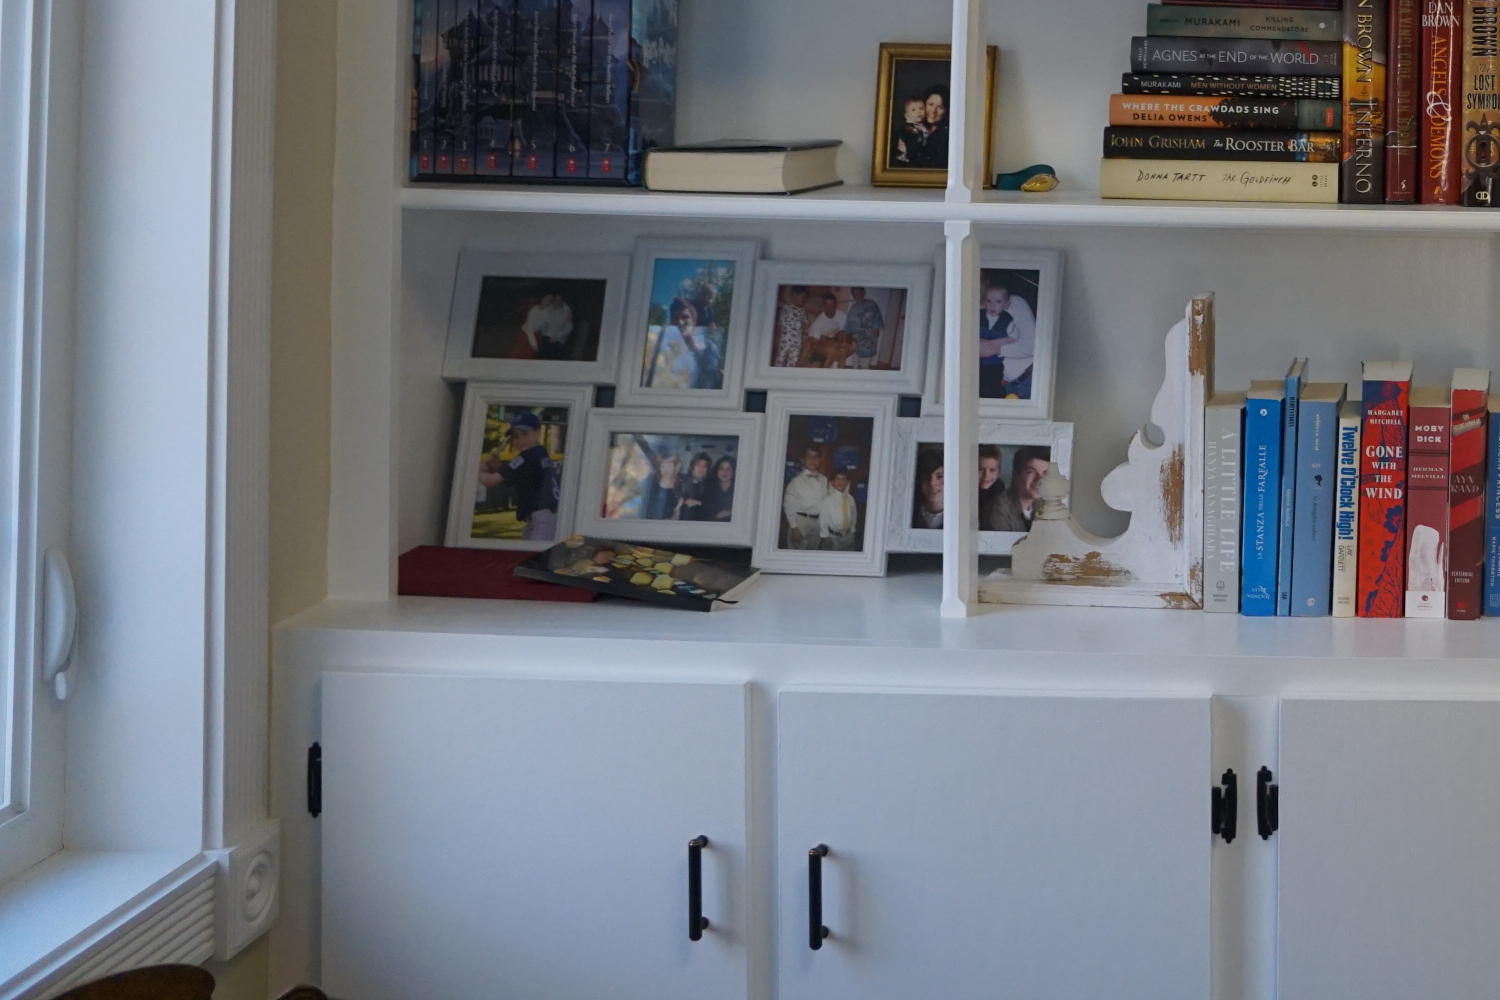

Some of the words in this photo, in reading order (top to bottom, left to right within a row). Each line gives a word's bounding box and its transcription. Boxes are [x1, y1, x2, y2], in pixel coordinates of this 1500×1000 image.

[1400, 0, 1413, 15] DA
[1428, 1, 1454, 14] DAN
[1184, 18, 1240, 27] MURAKAMI
[1421, 14, 1459, 27] BROWN
[1400, 17, 1413, 49] VINCI
[1471, 6, 1497, 57] BROWN
[1356, 14, 1372, 82] BROWN
[1152, 50, 1197, 62] AGNES
[1218, 50, 1247, 63] END
[1270, 51, 1319, 65] WORLD
[1430, 37, 1447, 94] ANGELS
[1400, 53, 1412, 80] CODE
[1209, 82, 1245, 90] WITHOUT
[1247, 83, 1277, 91] WOMEN
[1473, 75, 1496, 91] LOST
[1122, 103, 1160, 112] WHERE
[1164, 104, 1184, 112] THE
[1189, 104, 1250, 115] CRAWDADS
[1252, 105, 1279, 115] SING
[1399, 90, 1412, 112] DAN
[1425, 91, 1452, 121] &
[1466, 93, 1500, 110] SYMBOL
[1169, 114, 1207, 122] OWENS
[1110, 134, 1145, 148] JOHN
[1149, 135, 1206, 150] GRISHAM
[1224, 138, 1284, 152] ROOSTER
[1289, 140, 1314, 152] BAR
[1429, 115, 1446, 179] DEMONS
[1136, 169, 1168, 183] DONNA
[1172, 171, 1207, 183] TARTT
[1221, 430, 1236, 439] A
[1341, 426, 1358, 465] Twelve
[1365, 446, 1403, 458] GONE
[1257, 444, 1268, 492] FARFALLE
[1371, 461, 1397, 470] WITH
[1220, 448, 1236, 520] LITTLE
[1375, 475, 1393, 483] THE
[1340, 468, 1358, 508] O'Clock
[1365, 488, 1403, 499] WIND
[1255, 512, 1265, 552] STANZA
[1337, 511, 1356, 540] High!
[1219, 528, 1236, 573] LIFE
